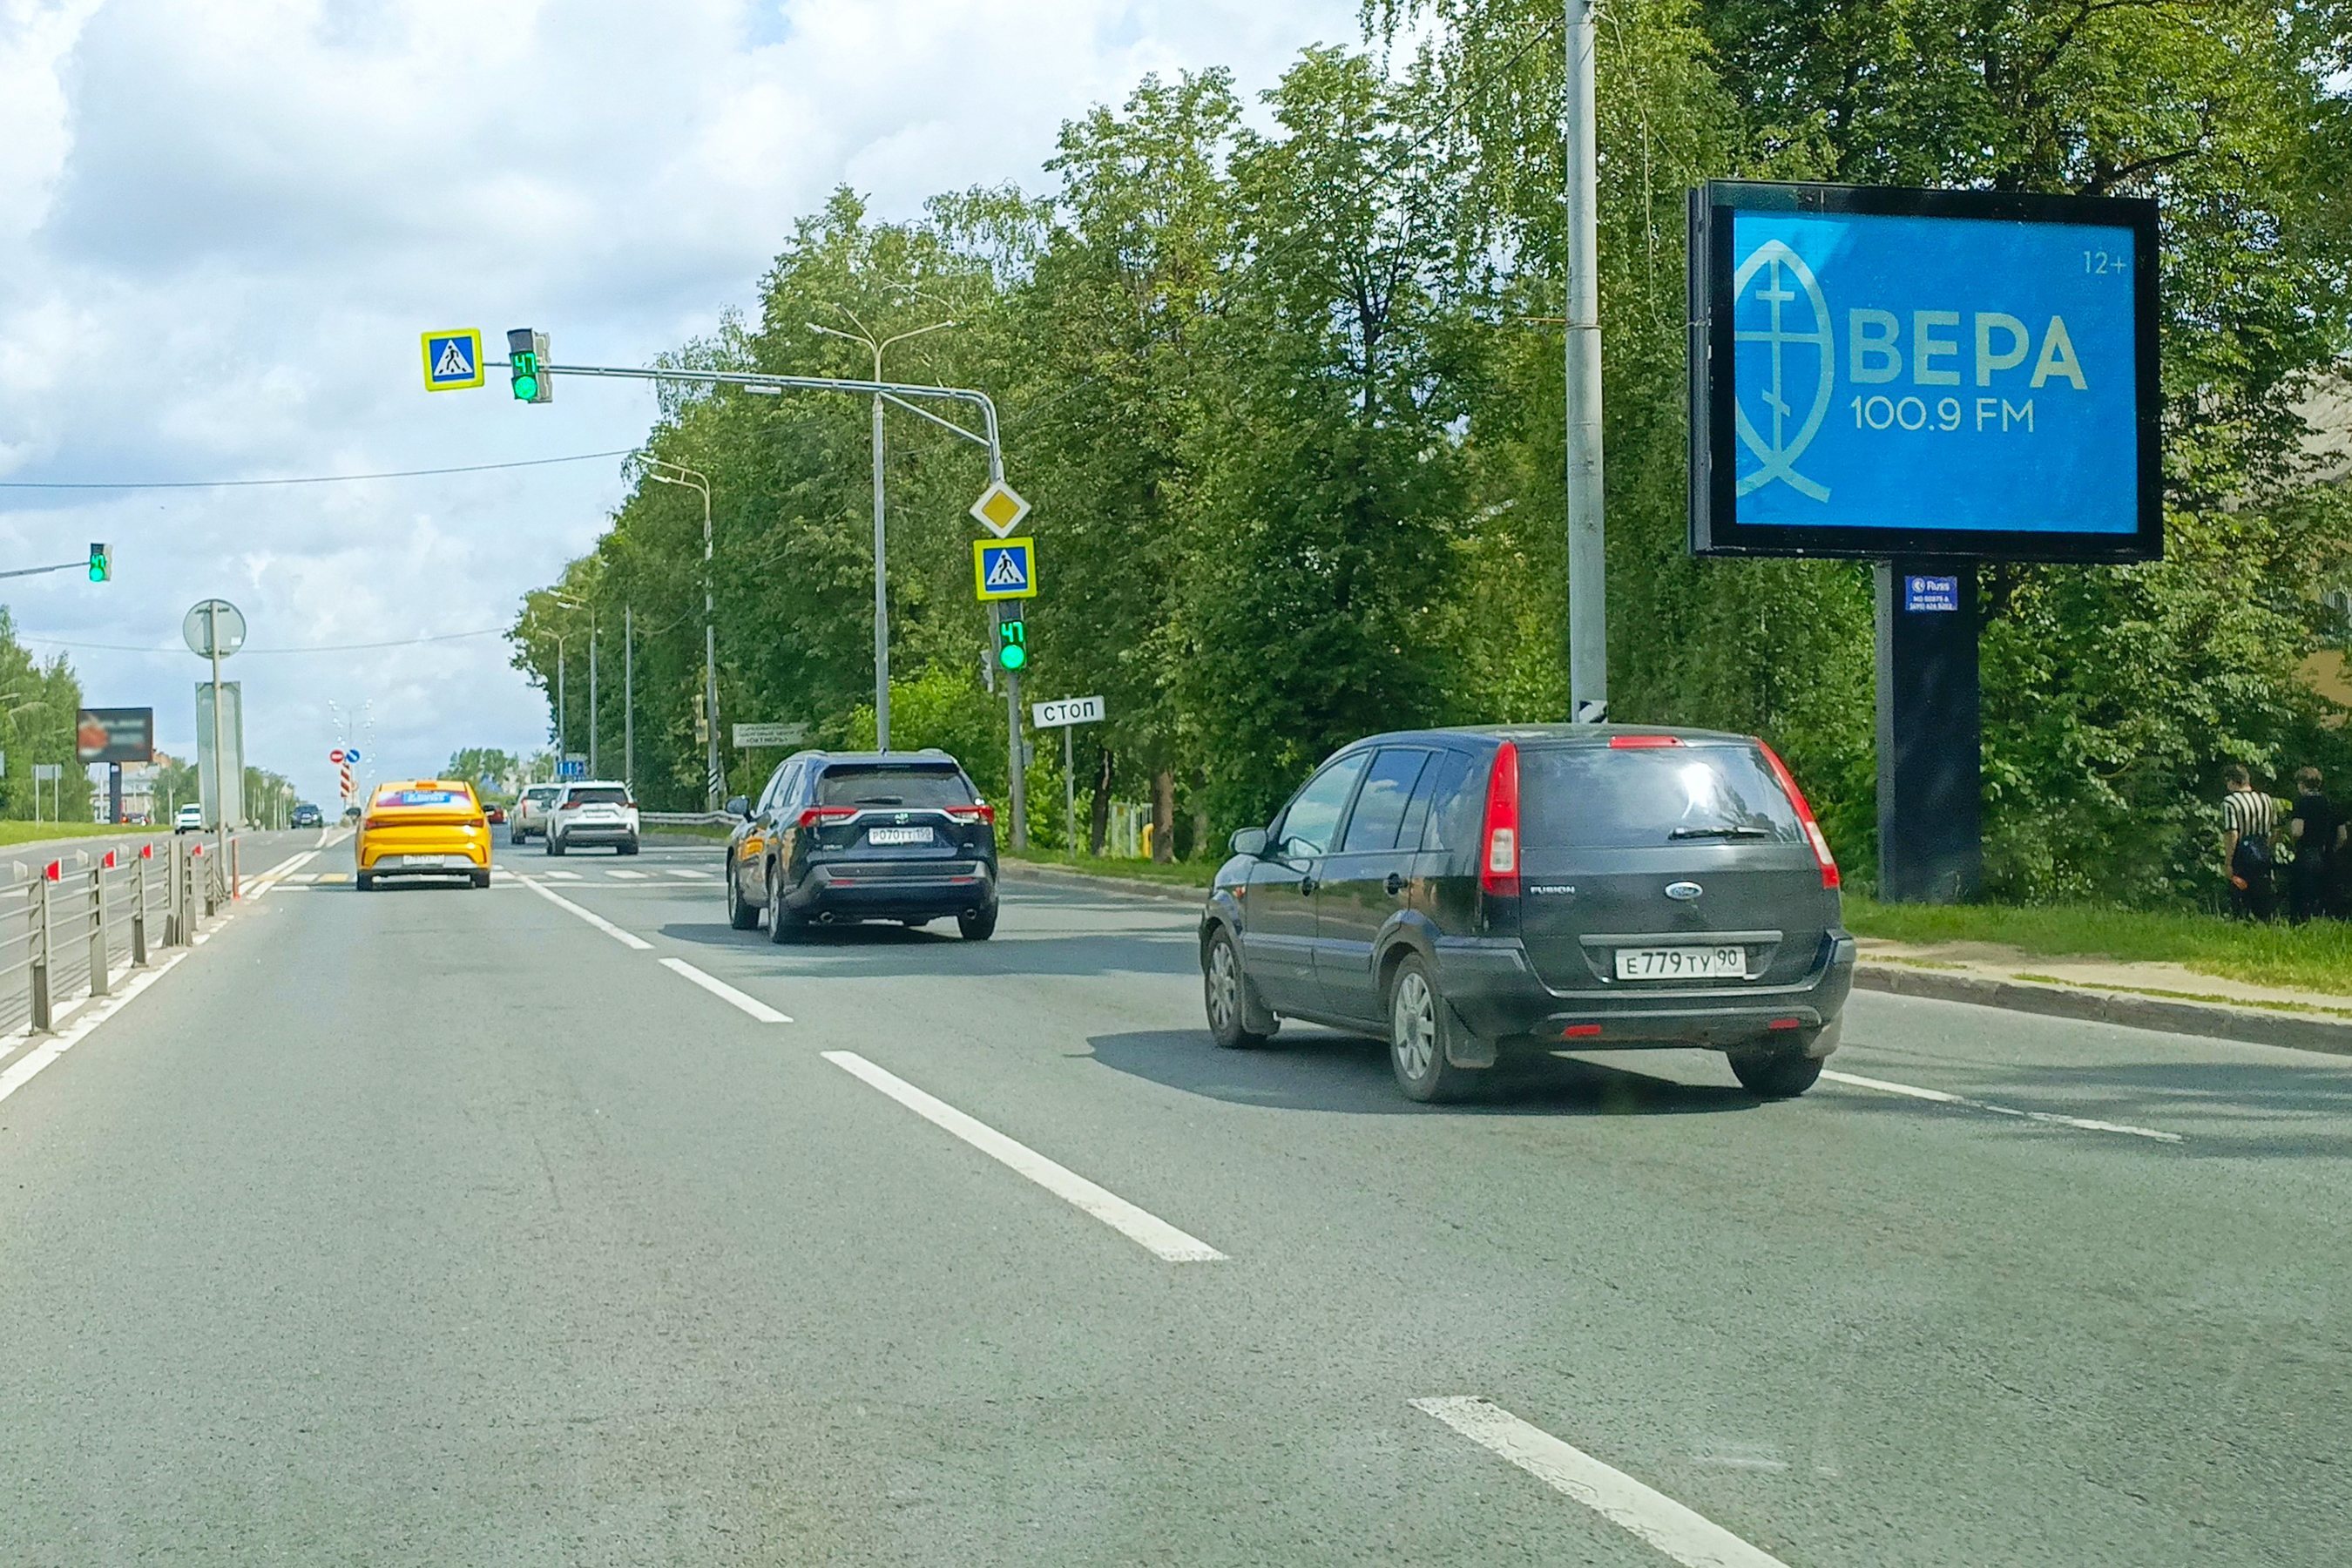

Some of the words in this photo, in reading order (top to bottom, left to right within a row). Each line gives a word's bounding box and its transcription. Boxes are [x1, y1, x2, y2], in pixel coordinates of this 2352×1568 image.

[2083, 251, 2127, 274] 12+
[1849, 308, 2089, 390] ВЕРА
[514, 353, 536, 373] 47
[1851, 395, 1960, 431] 100.9
[1976, 397, 2034, 433] FM
[1002, 621, 1024, 642] 47
[1044, 701, 1095, 721] СТОП
